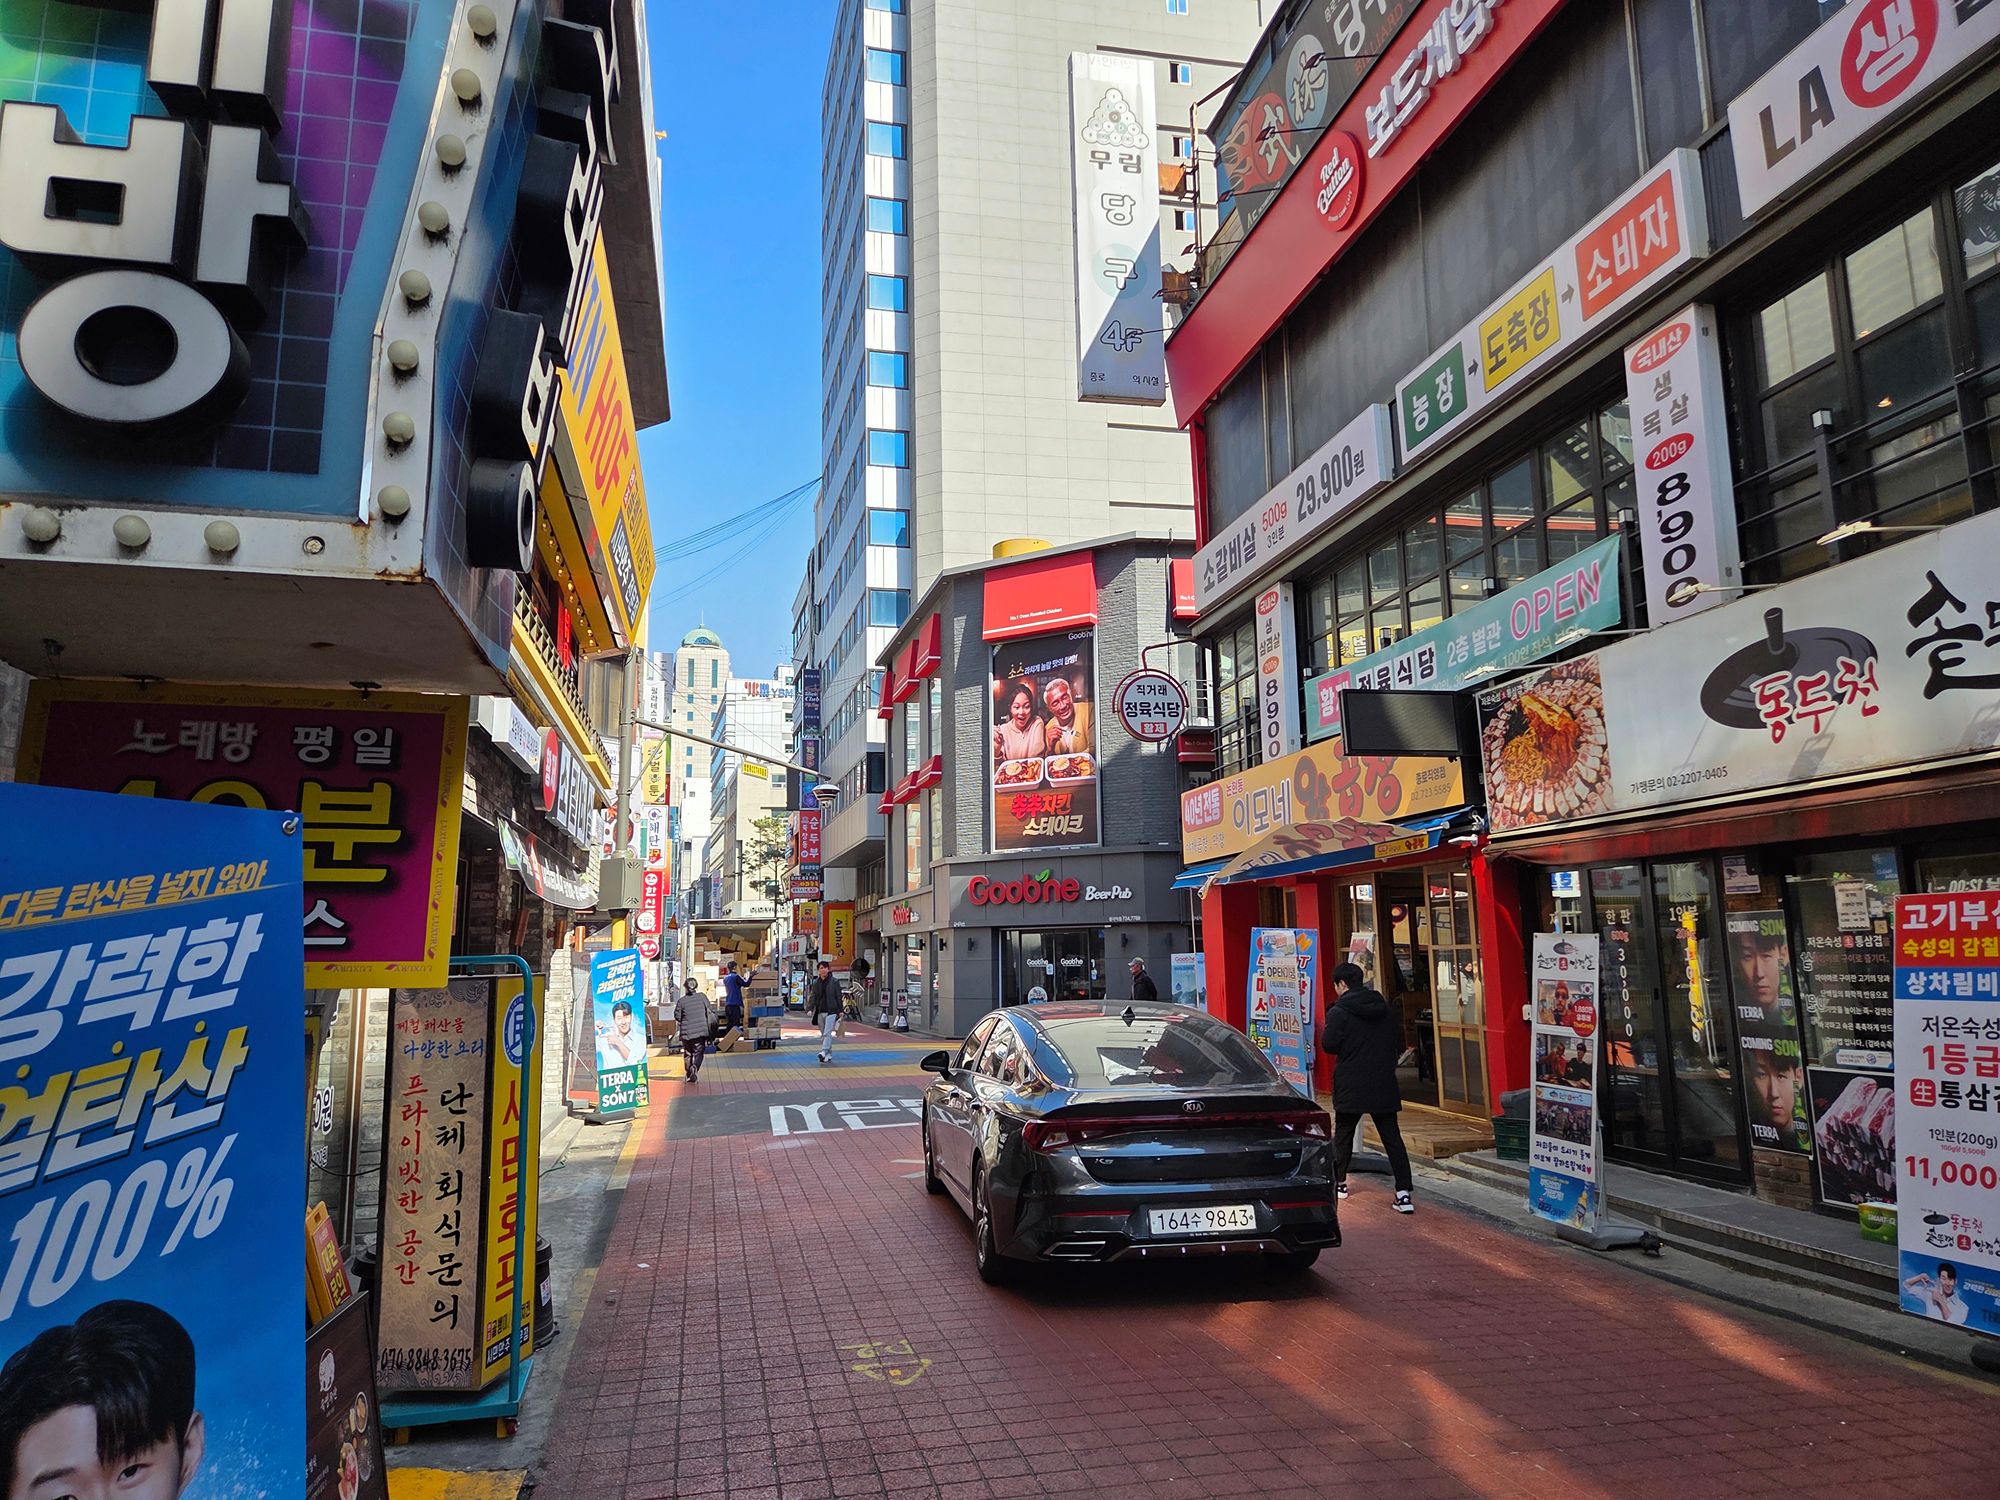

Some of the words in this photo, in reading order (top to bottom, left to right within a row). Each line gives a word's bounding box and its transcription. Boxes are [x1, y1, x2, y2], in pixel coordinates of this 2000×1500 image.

[1759, 65, 1835, 170] LA
[1856, 3, 1919, 93] 생
[1090, 150, 1142, 174] 무림
[1320, 147, 1339, 184] Red
[1317, 158, 1353, 214] Button
[1587, 195, 1670, 299] 소비자
[1100, 319, 1143, 352] 4F
[1486, 290, 1551, 375] 도축장
[1637, 328, 1687, 370] 국내산
[1412, 368, 1454, 430] 농장
[1653, 372, 1673, 398] 생
[585, 353, 629, 506] HOF
[1652, 439, 1687, 468] 200g
[1203, 522, 1257, 593] 소갈비살
[1262, 501, 1287, 532] 500g
[1296, 445, 1365, 523] 29,900원
[1266, 526, 1285, 548] 3인분
[1447, 637, 1469, 667] 2층
[1473, 620, 1501, 657] 별관
[1511, 559, 1600, 640] OPEN
[1259, 633, 1280, 657] 삼겹살
[771, 688, 793, 698] YBM
[1136, 685, 1168, 696] 직거래
[1751, 656, 1883, 744] 동두천
[1125, 702, 1180, 717] 정육식당
[113, 719, 258, 763] 노래방
[1630, 774, 1665, 794] 가맹문의
[1667, 766, 1728, 788] 02-2207-0405
[1232, 778, 1291, 837] 이모네
[809, 816, 819, 858] 순두부
[63, 873, 154, 915] 탄산을
[162, 866, 218, 904] 넣지
[219, 859, 269, 895] 않아
[1085, 885, 1111, 901] Beer
[1111, 885, 1132, 900] Pub
[835, 919, 843, 948] Alpha
[1728, 919, 1759, 933] COMING
[1807, 936, 1842, 948] 저온숙성
[1902, 936, 1955, 958] 숙성의
[0, 912, 264, 1062] 강력한
[612, 987, 635, 1002] 100%
[1906, 971, 1998, 997] 상차림비
[396, 1018, 420, 1034] 제철
[424, 1017, 465, 1034] 해산물
[1273, 1013, 1300, 1033] 서비스
[1738, 1005, 1764, 1020] TERRA
[1921, 1015, 2000, 1040] 저온숙성
[403, 1039, 452, 1060] 다양한
[454, 1038, 484, 1058] 요리
[1741, 1036, 1773, 1050] COMING
[1922, 1043, 2000, 1078] 1등급
[601, 1070, 634, 1089] TERRA
[435, 1082, 475, 1155] 단체
[1752, 1124, 1779, 1141] TERRA
[399, 1074, 429, 1214] 프라이빗한
[1929, 1128, 1998, 1150] 1인분(200g)
[0, 1133, 239, 1322] 100%
[1206, 1209, 1249, 1228] 9843
[1951, 1213, 1983, 1234] 동두천
[394, 1231, 423, 1286] 공간
